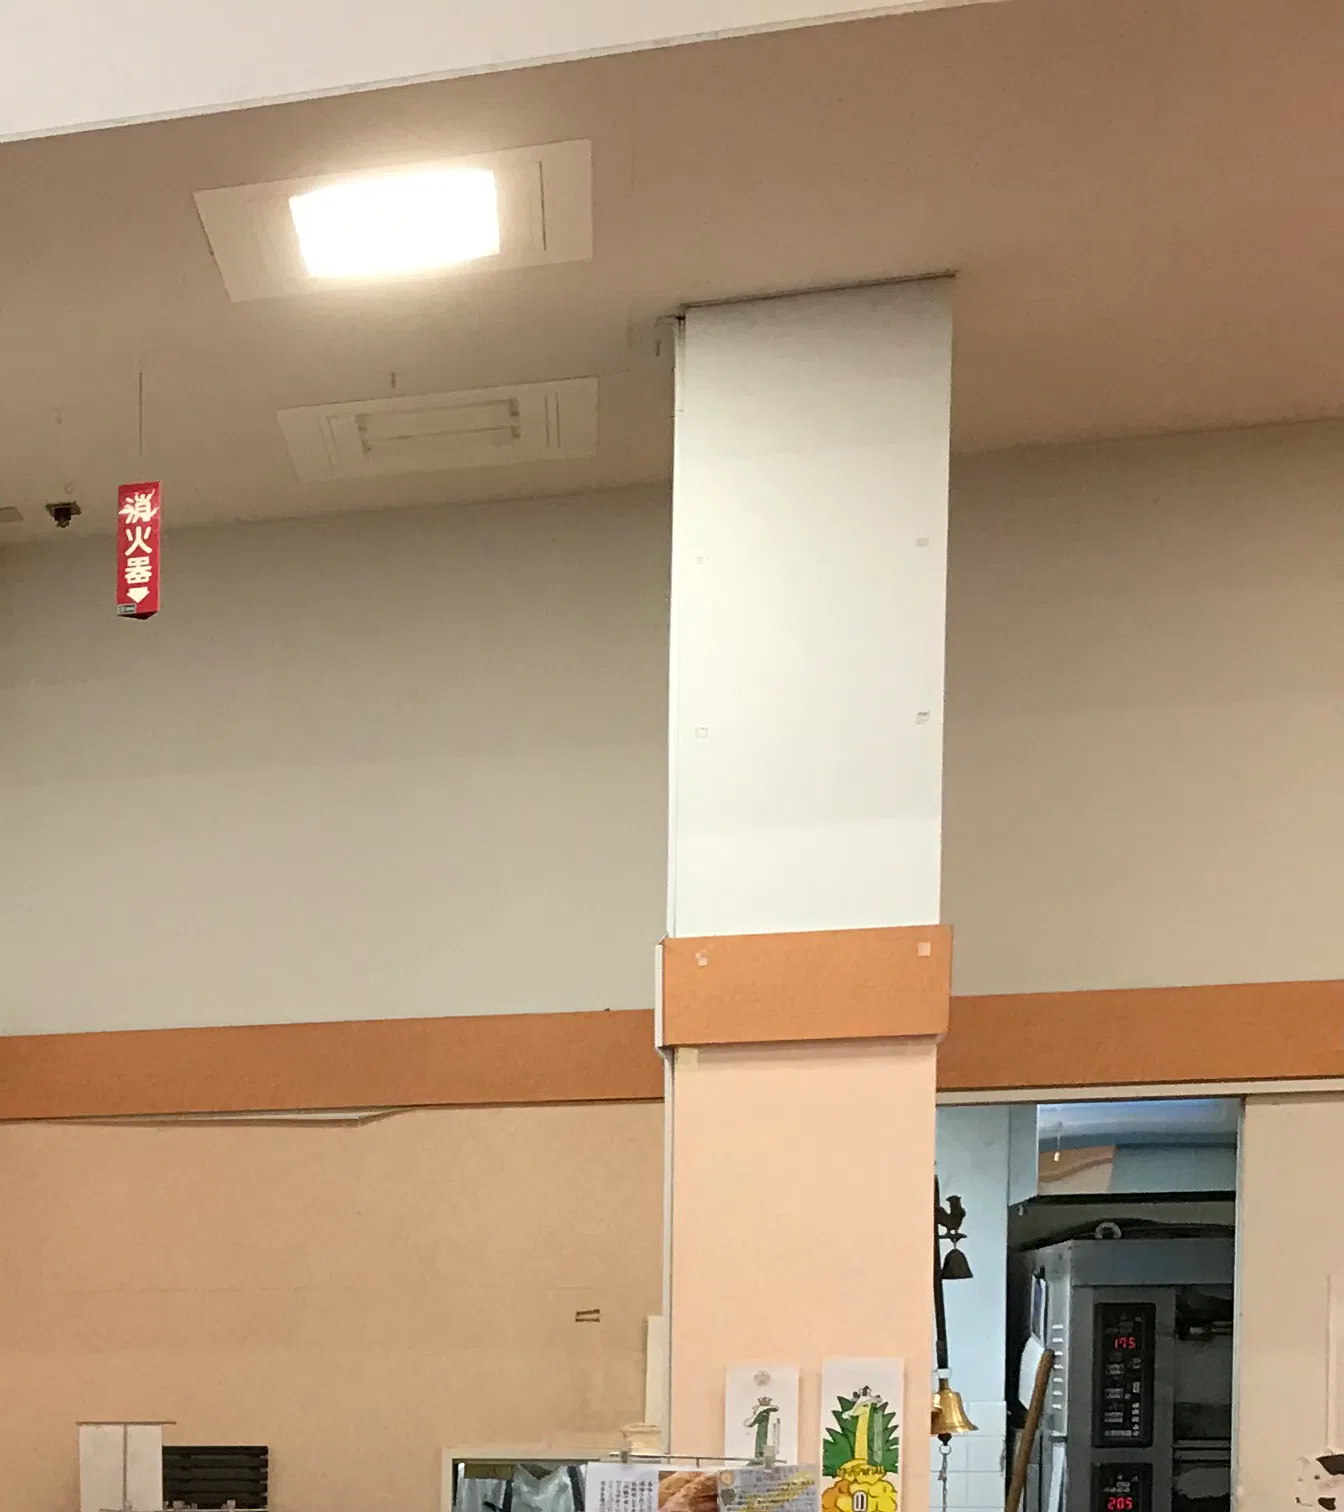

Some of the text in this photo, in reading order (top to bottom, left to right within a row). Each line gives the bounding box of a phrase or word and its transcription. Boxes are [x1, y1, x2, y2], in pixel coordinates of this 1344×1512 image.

[119, 489, 159, 584] 消火器
[1107, 1497, 1133, 1510] 205
